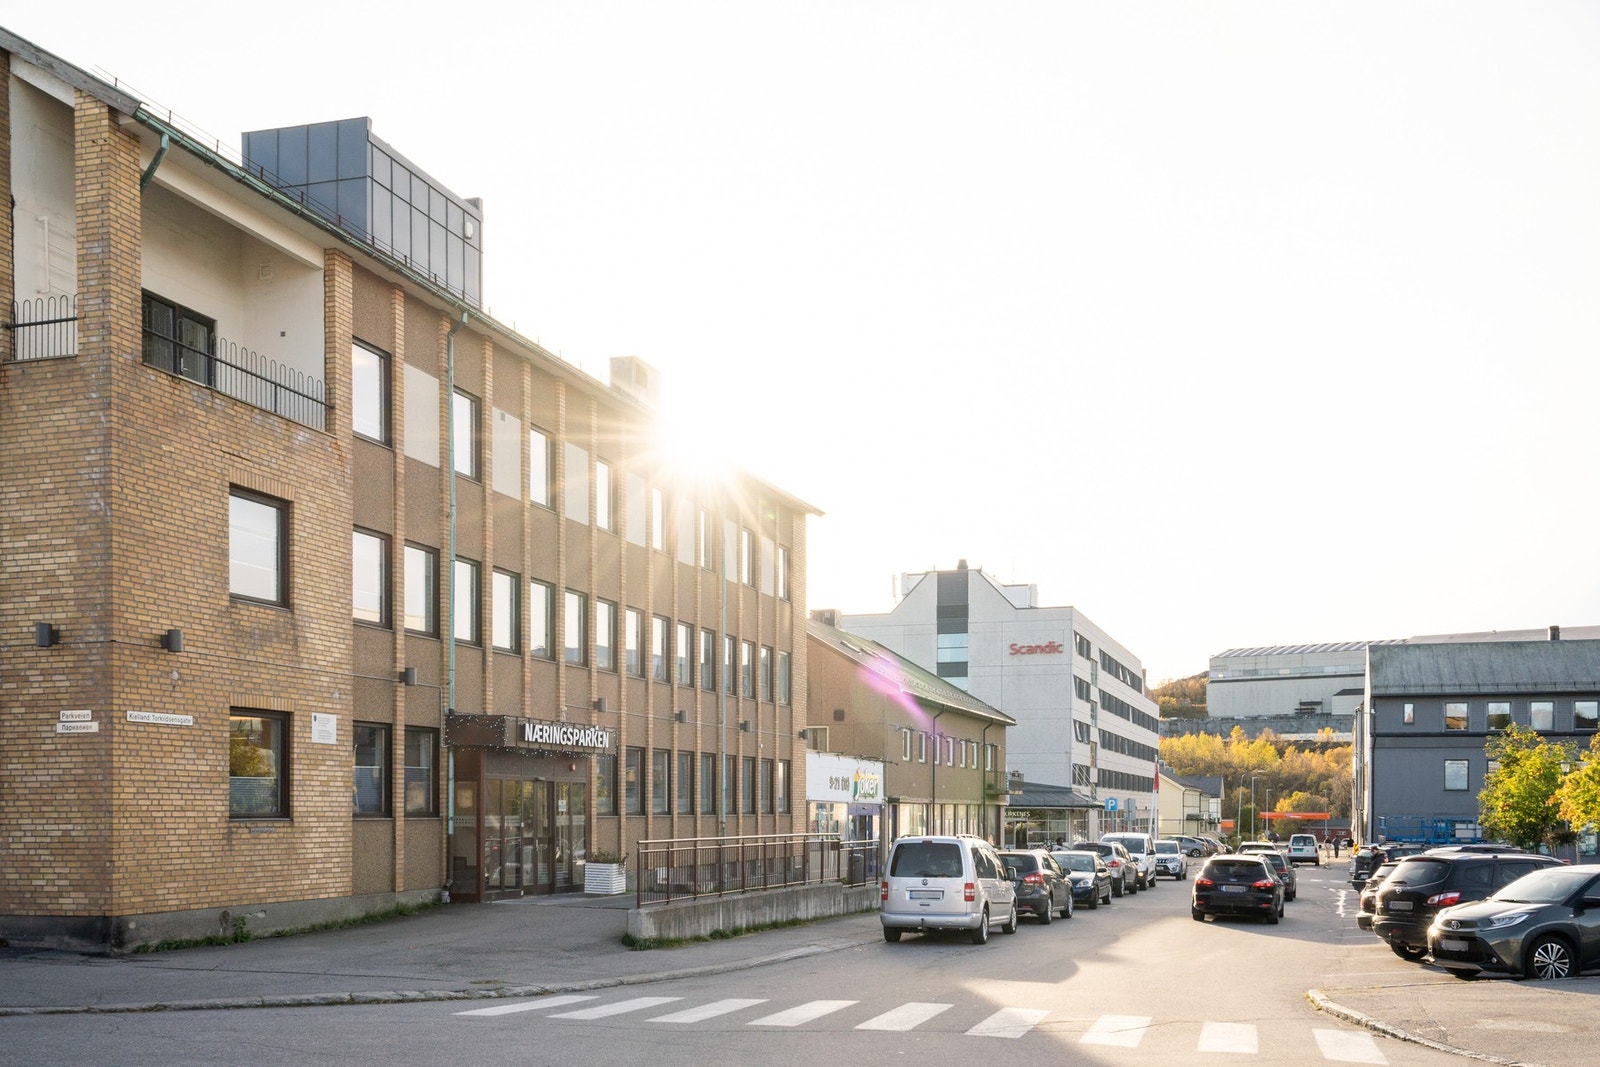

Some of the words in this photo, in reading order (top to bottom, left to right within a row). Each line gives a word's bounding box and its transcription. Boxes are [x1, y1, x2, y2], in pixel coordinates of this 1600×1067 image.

[1009, 641, 1063, 655] Scandic
[129, 712, 150, 720] Kielland
[524, 723, 609, 748] NÆRINGSPARKEN
[1107, 799, 1116, 811] P
